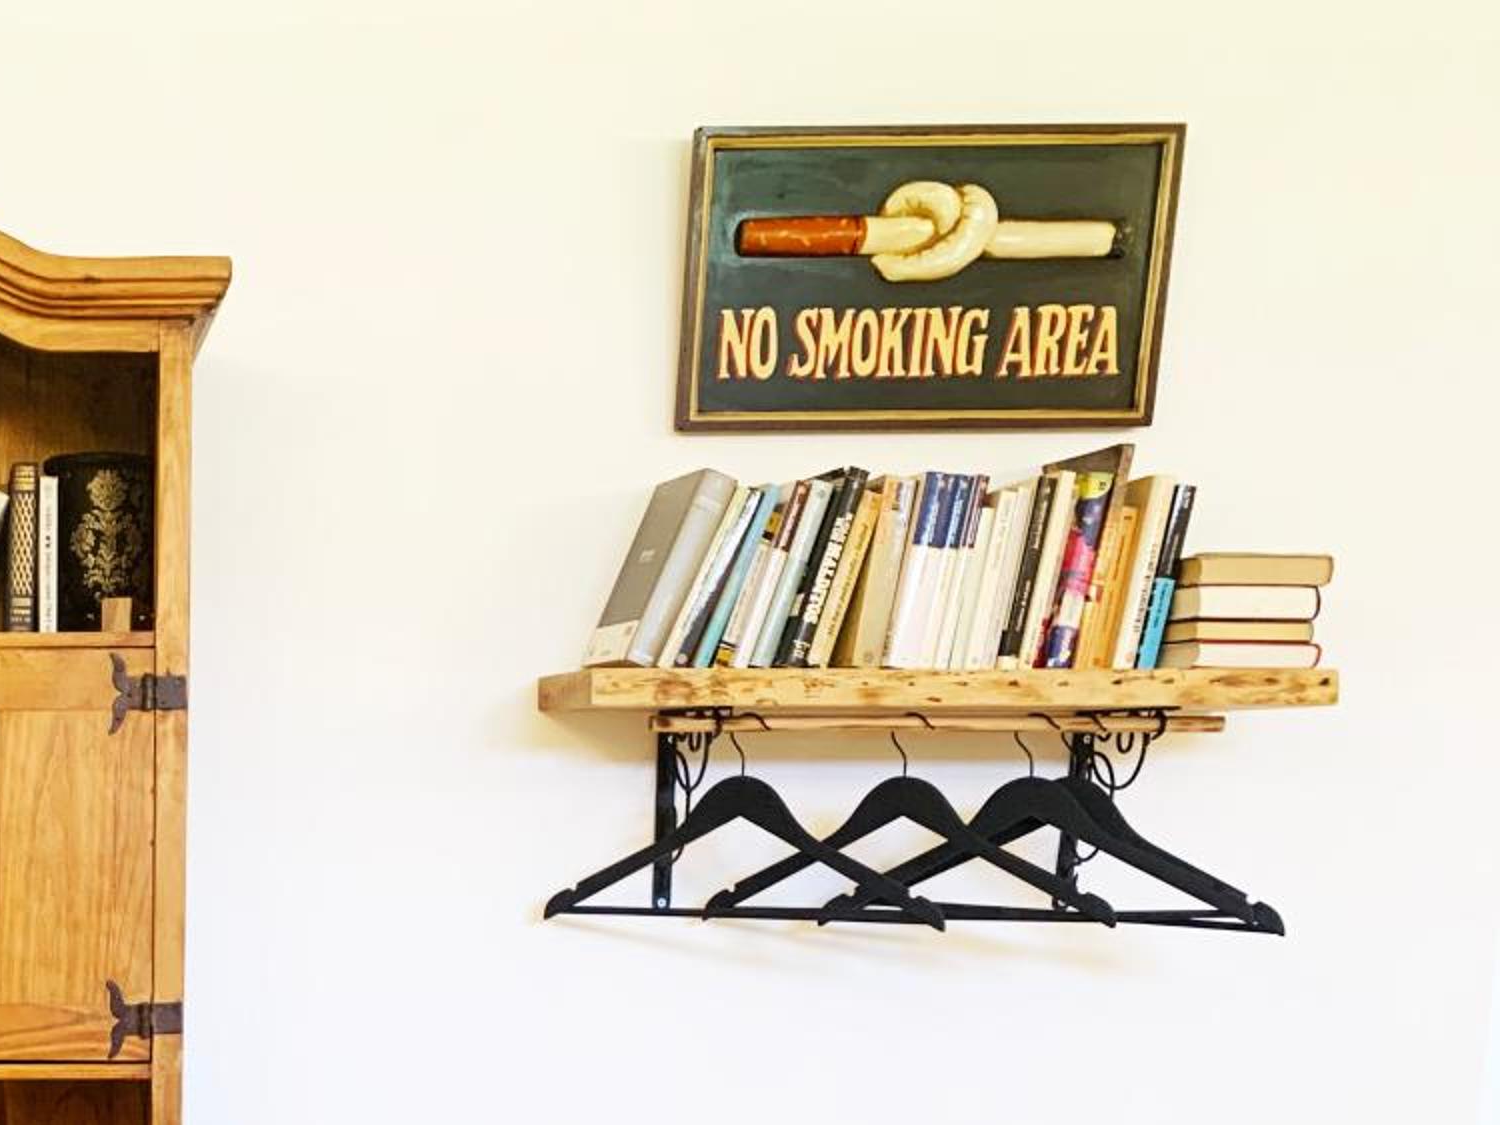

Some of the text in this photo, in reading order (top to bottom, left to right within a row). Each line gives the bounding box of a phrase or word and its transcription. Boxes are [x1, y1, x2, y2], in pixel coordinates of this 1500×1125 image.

[717, 304, 1121, 380] NO SMOKING AREA
